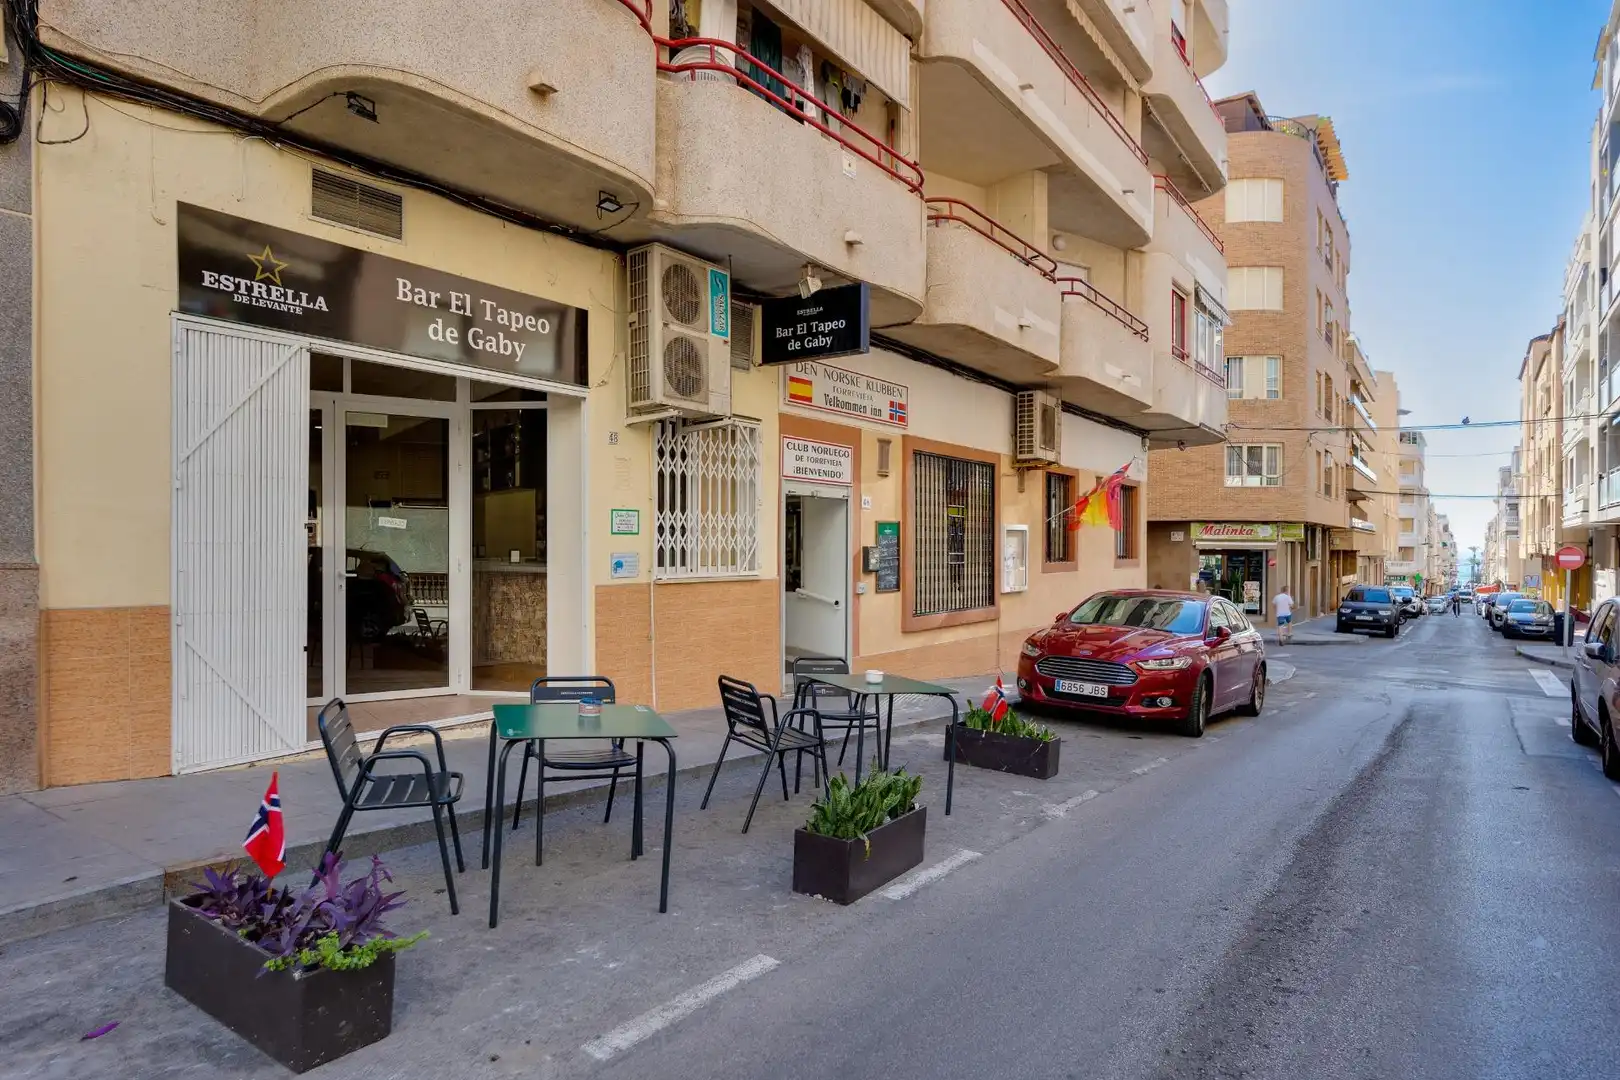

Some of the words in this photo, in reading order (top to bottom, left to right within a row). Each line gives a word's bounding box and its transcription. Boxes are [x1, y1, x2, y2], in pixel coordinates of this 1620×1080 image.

[201, 270, 329, 312] ESTRELLA
[233, 293, 250, 305] DE
[251, 296, 304, 315] LEVANTE
[396, 278, 441, 309] Bar
[449, 290, 472, 317] El
[480, 299, 551, 335] Tapeo
[775, 326, 794, 338] Bar
[796, 322, 807, 335] El
[810, 319, 846, 333] Tapeo
[428, 318, 459, 345] de
[467, 328, 526, 362] Gaby
[787, 339, 801, 351] de
[804, 334, 833, 348] Gaby
[795, 362, 818, 376] DEN
[823, 367, 861, 388] NORSKE
[866, 379, 903, 398] KLUBBEN
[823, 393, 868, 413] Velkommen
[870, 404, 882, 417] inn
[786, 441, 809, 452] CLUB
[811, 445, 850, 458] NORUEGO
[795, 454, 804, 462] DE
[806, 455, 842, 467] TORREVIEJA
[1200, 524, 1255, 537] Malinka
[1061, 681, 1085, 693] 6856
[1088, 685, 1106, 696] JBS
